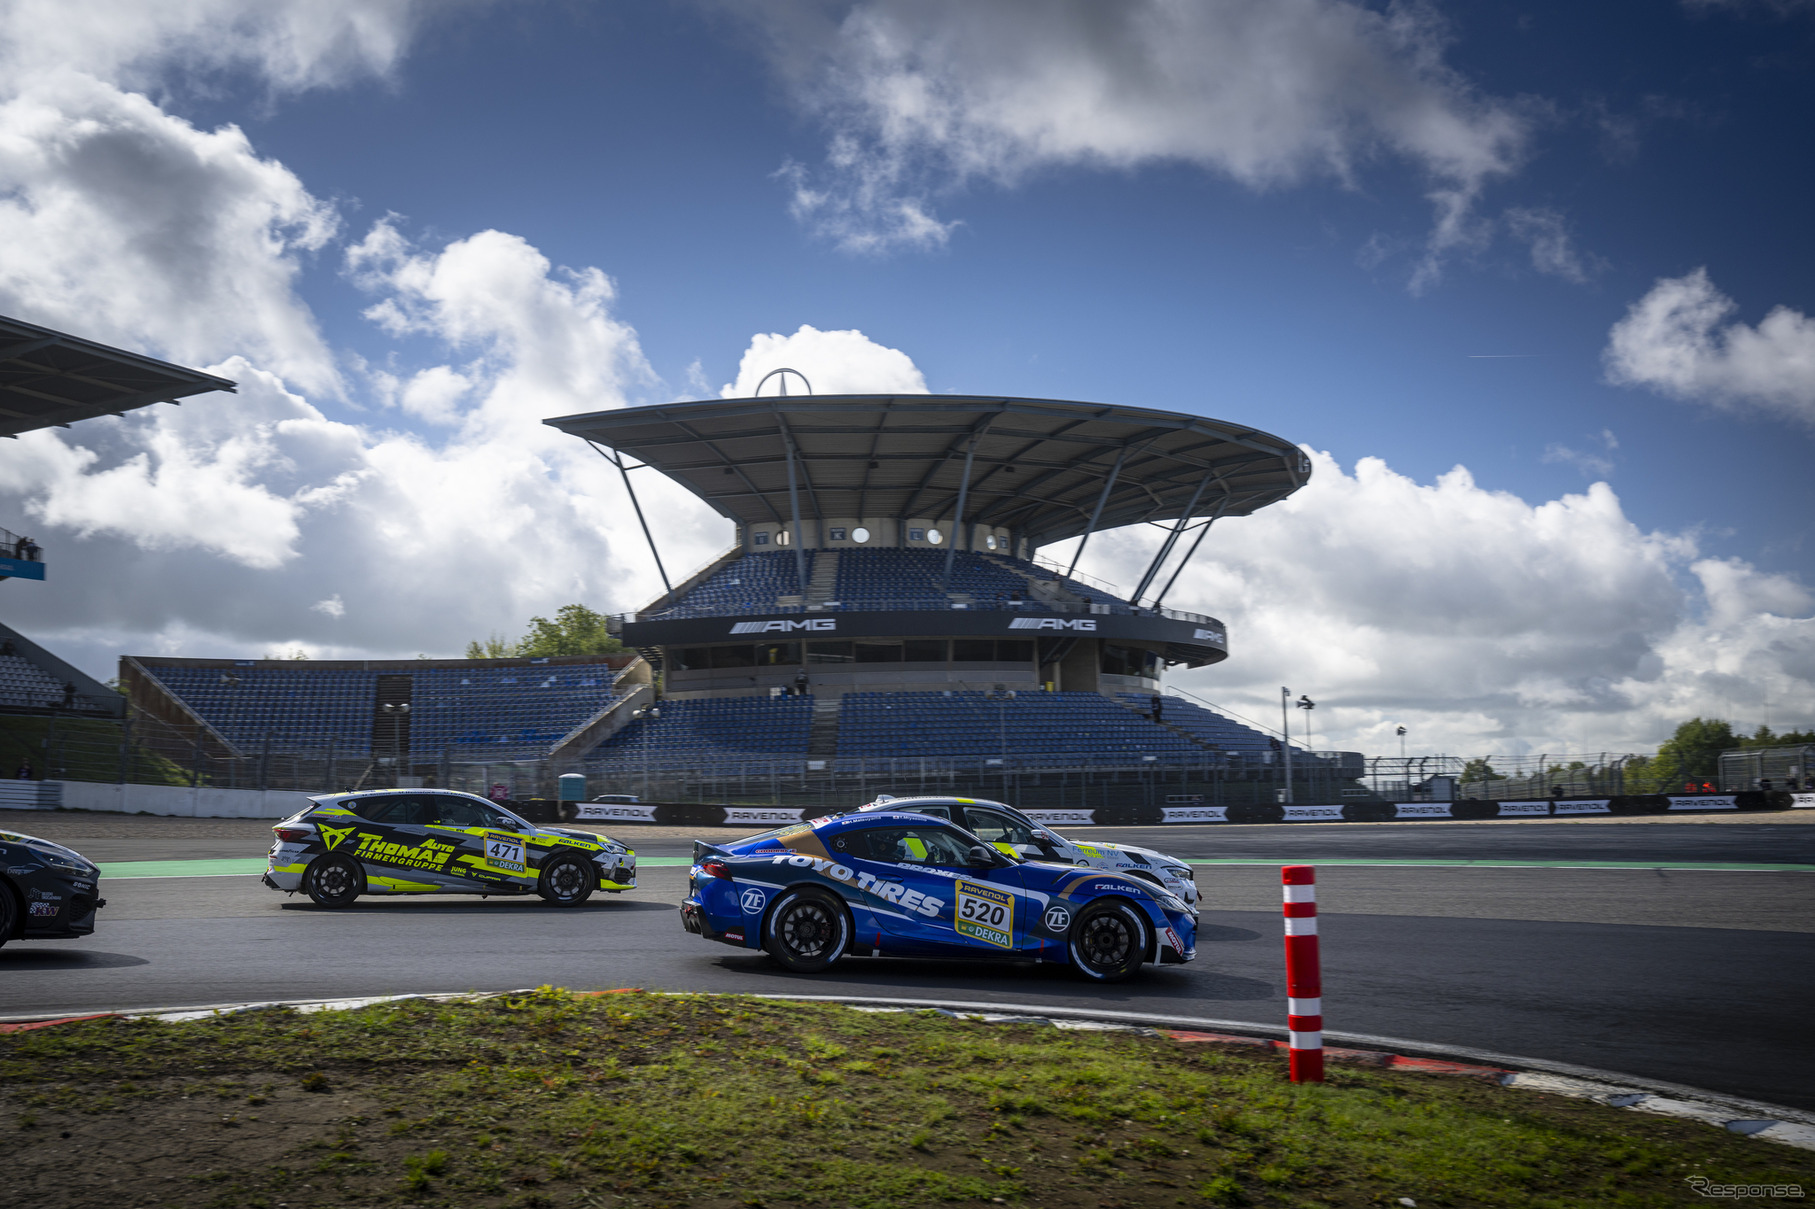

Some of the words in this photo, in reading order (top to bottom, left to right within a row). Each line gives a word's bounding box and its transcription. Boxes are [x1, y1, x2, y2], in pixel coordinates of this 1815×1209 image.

[764, 618, 837, 632] AMG
[1038, 617, 1098, 631] AMG
[583, 806, 650, 818] RAVENOL
[1288, 808, 1338, 817] RAVENOL
[1401, 806, 1448, 814] RAVENOL
[1503, 804, 1547, 812] RAVENOL
[1560, 803, 1605, 811] RAVENOL
[732, 811, 799, 820] RAVENOL
[1168, 810, 1222, 819] RAVENOL
[489, 833, 520, 844] RAVENOL
[558, 838, 592, 848] FALKEN
[357, 832, 451, 864] THOMAS
[419, 838, 456, 853] AUTO
[490, 843, 519, 860] 471
[1072, 845, 1105, 856] Ferreum
[1106, 849, 1120, 857] NV
[353, 849, 444, 871] FIRMENGRUPPE
[499, 860, 524, 872] DEKRA
[1115, 862, 1152, 870] FALKEN
[451, 866, 467, 874] JUNG
[771, 855, 854, 881] TOYO
[857, 871, 945, 917] TIRES
[1094, 883, 1141, 895] FALKEN
[963, 884, 1007, 902] RAVENOL
[743, 891, 765, 910] ZF
[961, 898, 1005, 926] 520
[1047, 911, 1070, 927] ZF
[975, 926, 1009, 946] DEKRA
[1167, 931, 1182, 954] MOTUL
